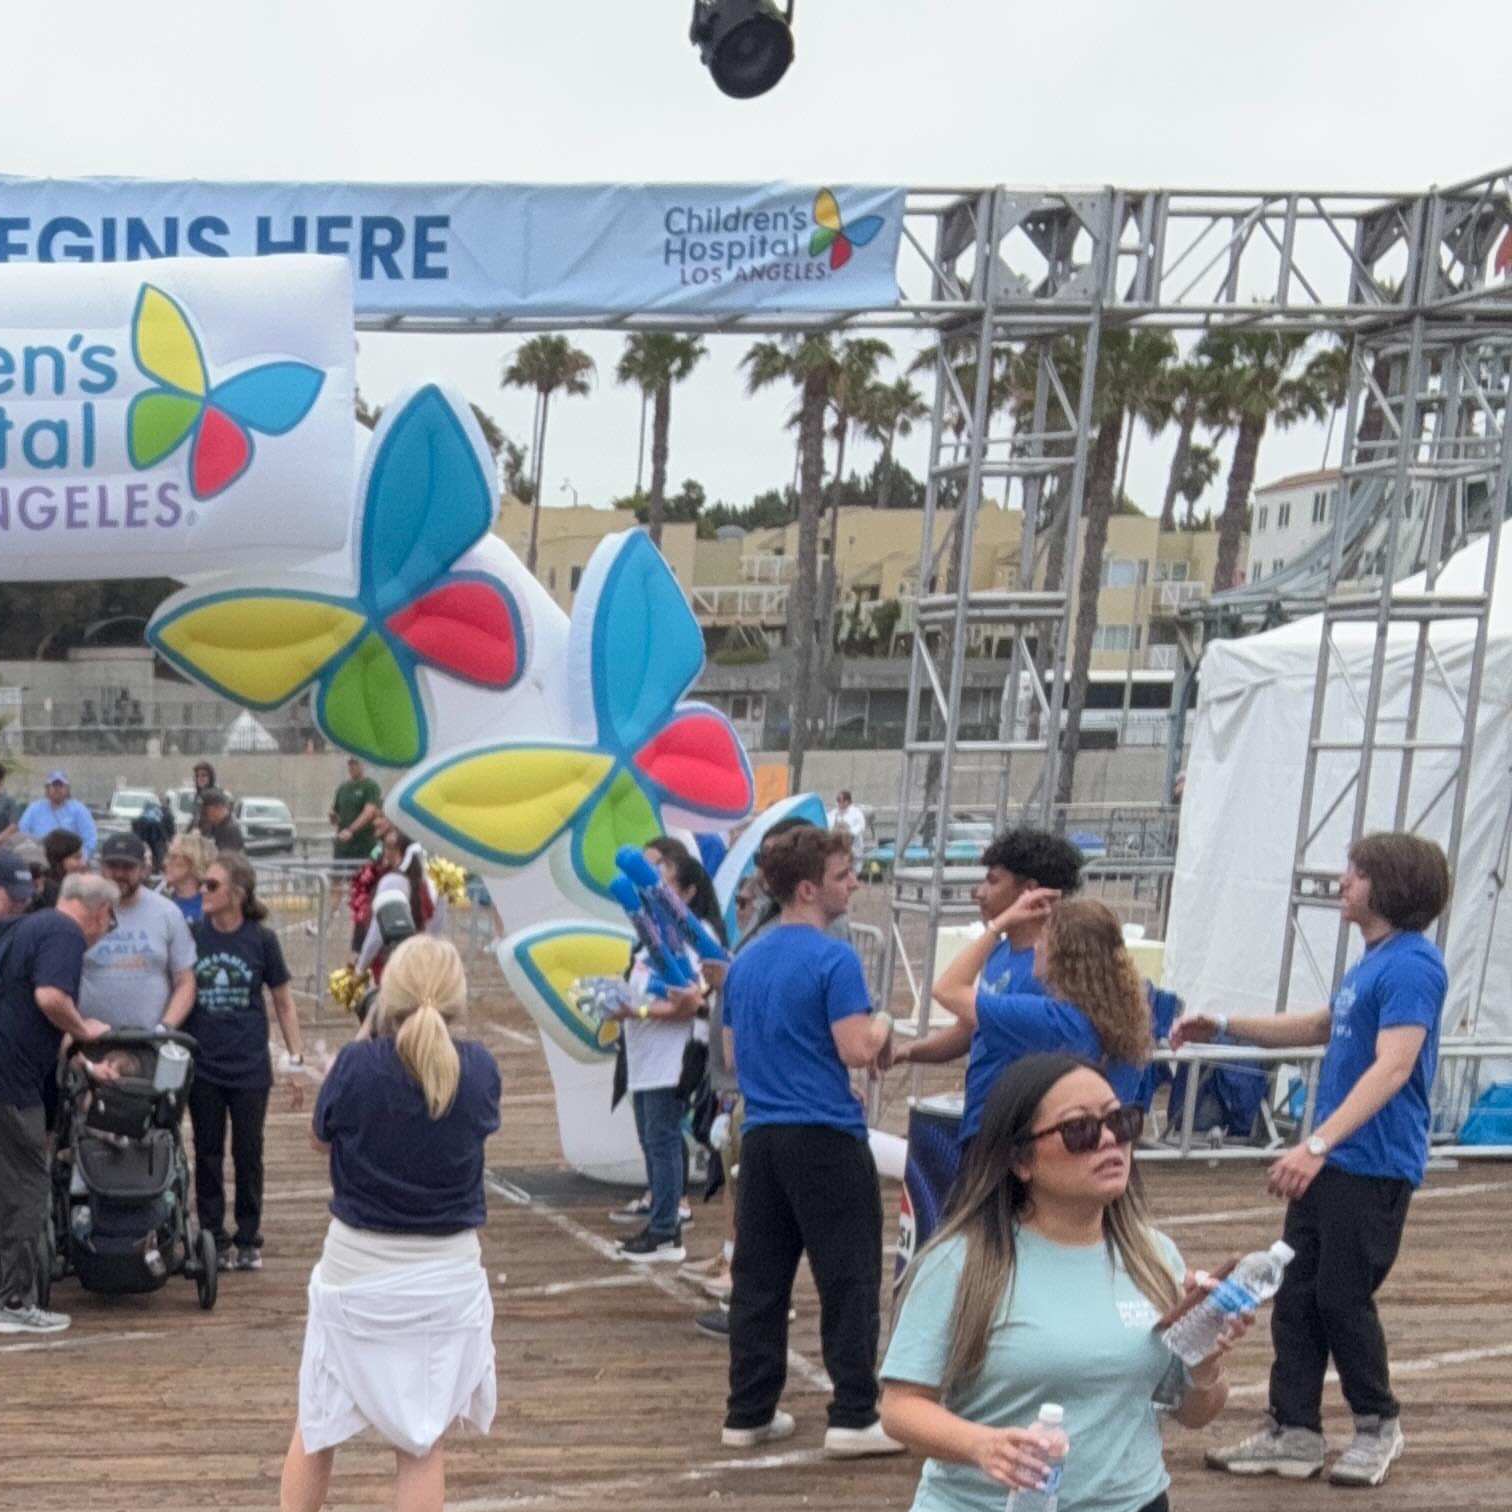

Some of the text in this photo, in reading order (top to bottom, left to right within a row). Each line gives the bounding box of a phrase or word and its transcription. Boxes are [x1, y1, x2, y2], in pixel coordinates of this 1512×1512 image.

[664, 205, 807, 236] Children's
[256, 214, 451, 280] HERE
[664, 233, 799, 270] Hospital
[680, 261, 827, 286] LOS ANGELES
